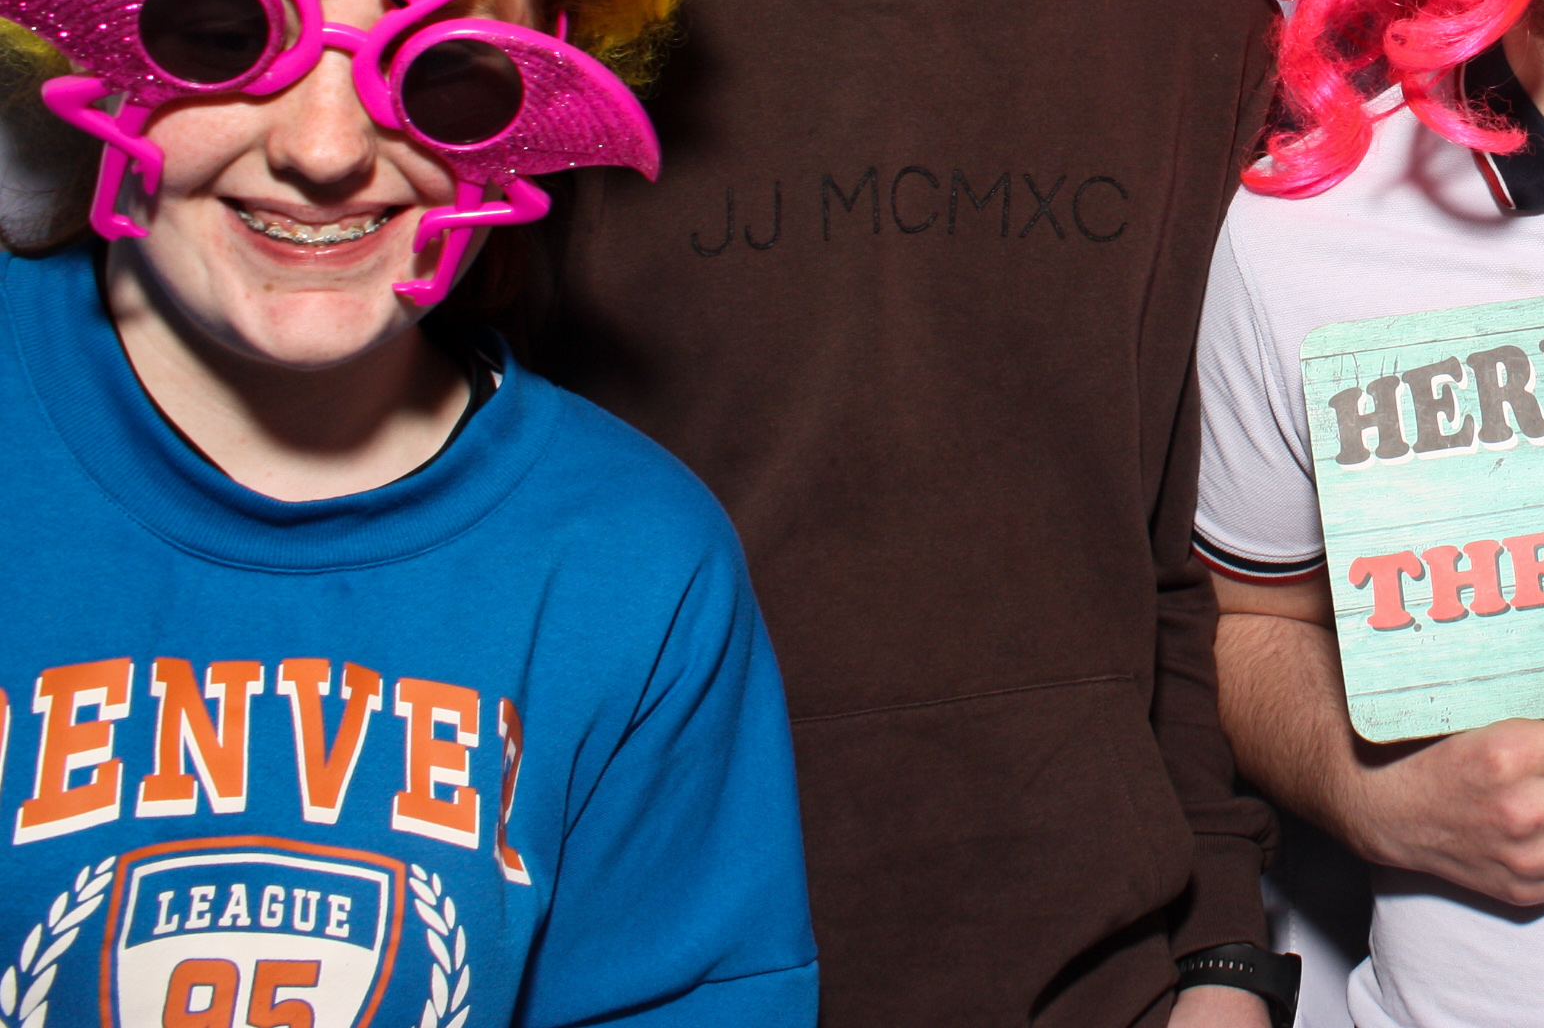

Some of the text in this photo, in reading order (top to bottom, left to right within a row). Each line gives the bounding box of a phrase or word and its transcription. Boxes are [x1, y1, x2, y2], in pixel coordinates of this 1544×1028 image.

[691, 165, 1130, 257] JJ MCMXC
[0, 656, 533, 886] ENVER
[152, 883, 352, 938] LEAGUE
